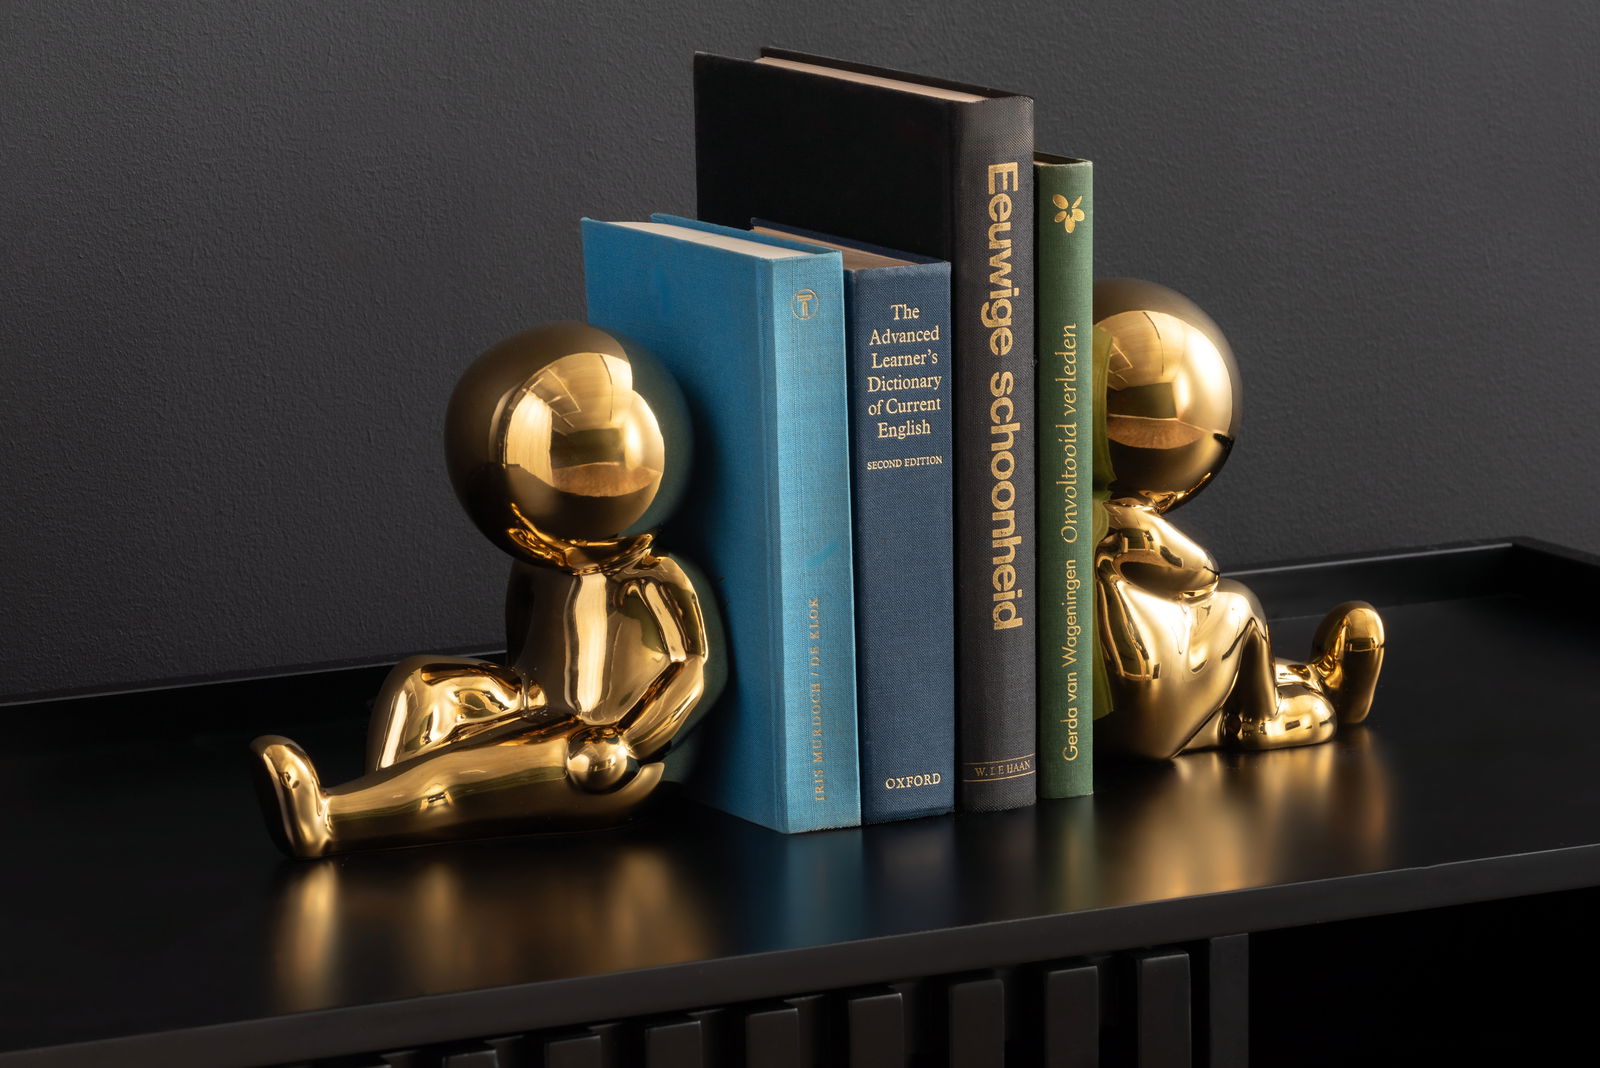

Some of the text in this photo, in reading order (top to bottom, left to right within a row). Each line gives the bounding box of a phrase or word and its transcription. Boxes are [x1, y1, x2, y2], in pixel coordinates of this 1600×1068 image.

[891, 304, 920, 321] The
[869, 326, 940, 346] Advanced
[871, 349, 938, 369] Learner's
[867, 375, 942, 393] Dictionary
[980, 161, 1024, 631] Eeuwige schoonheid
[868, 397, 941, 416] of Current
[877, 419, 931, 440] English
[1055, 322, 1078, 543] Onvoltooid verleden
[867, 455, 943, 470] SECOND EDITION
[809, 596, 821, 640] KLOK
[809, 645, 822, 667] DE
[1060, 559, 1081, 761] Gerda van Wageningen
[811, 682, 825, 763] MURDOCH
[974, 767, 988, 777] W.
[1006, 760, 1032, 774] HAAN
[814, 768, 826, 802] IRIS
[885, 772, 941, 790] OXFORD
